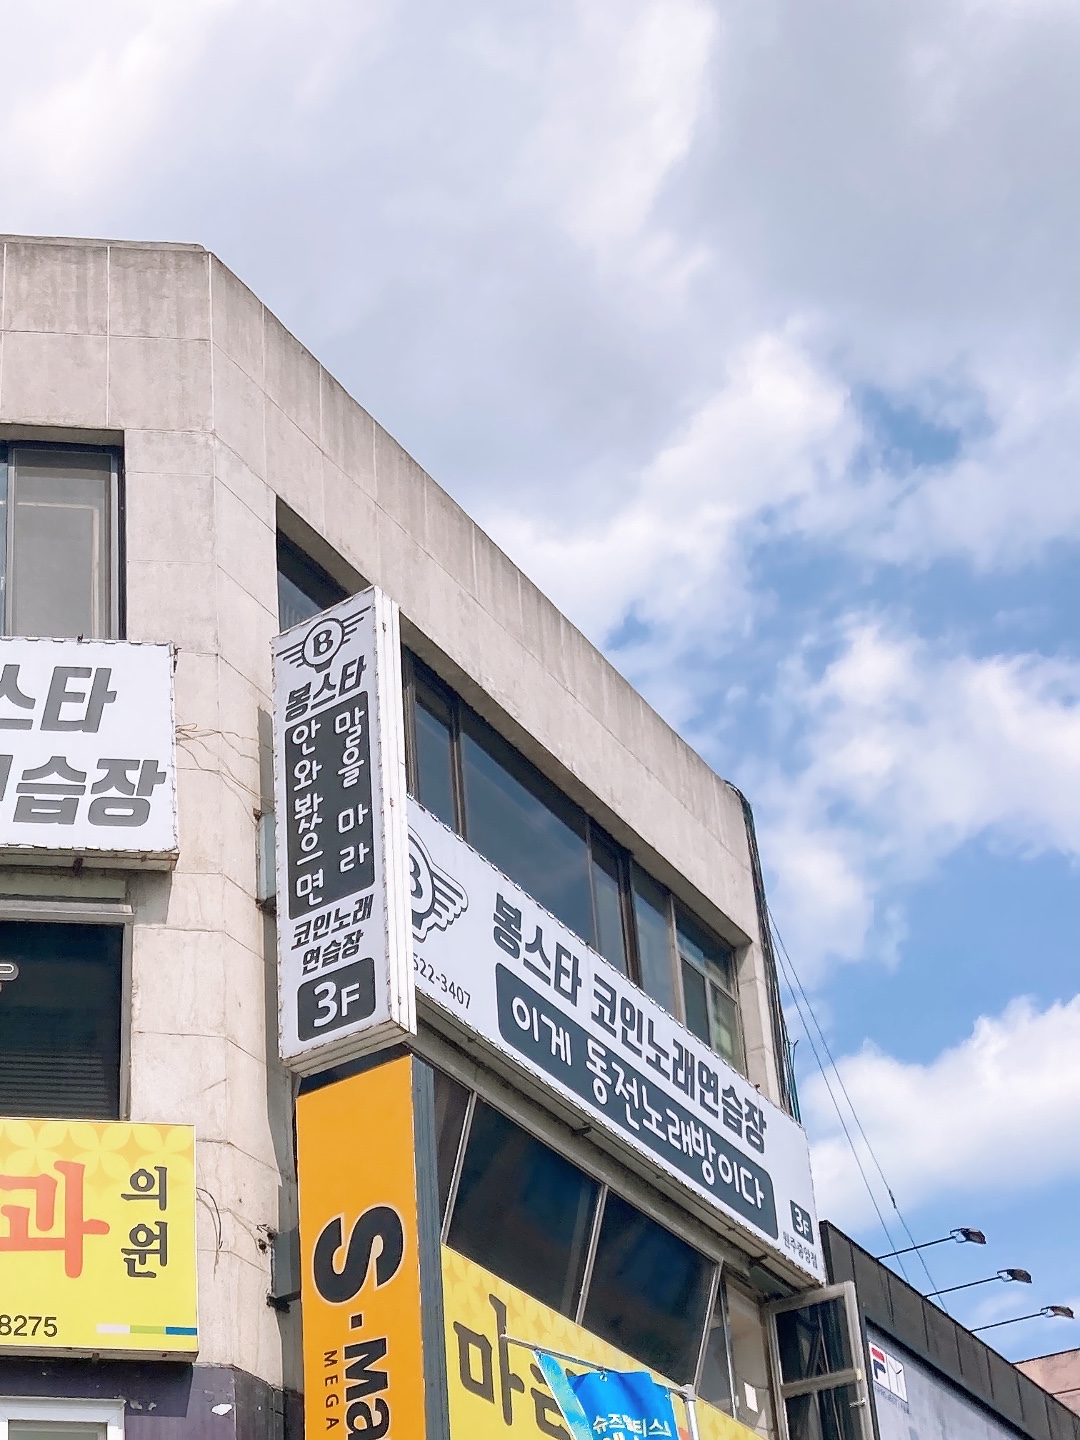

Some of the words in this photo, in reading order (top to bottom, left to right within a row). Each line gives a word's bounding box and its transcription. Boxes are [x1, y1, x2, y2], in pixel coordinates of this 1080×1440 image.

[284, 656, 367, 722] 봉스타
[291, 894, 373, 950] 코인노래
[302, 930, 364, 976] 연습장
[314, 980, 360, 1027] 3F
[493, 892, 582, 1006] 봉스타
[590, 972, 767, 1155] 코인노래연습장
[511, 996, 572, 1068] 이게
[585, 1039, 765, 1211] 동전노래방이다
[794, 1207, 810, 1236] 3F
[321, 1350, 338, 1428] MEGA
